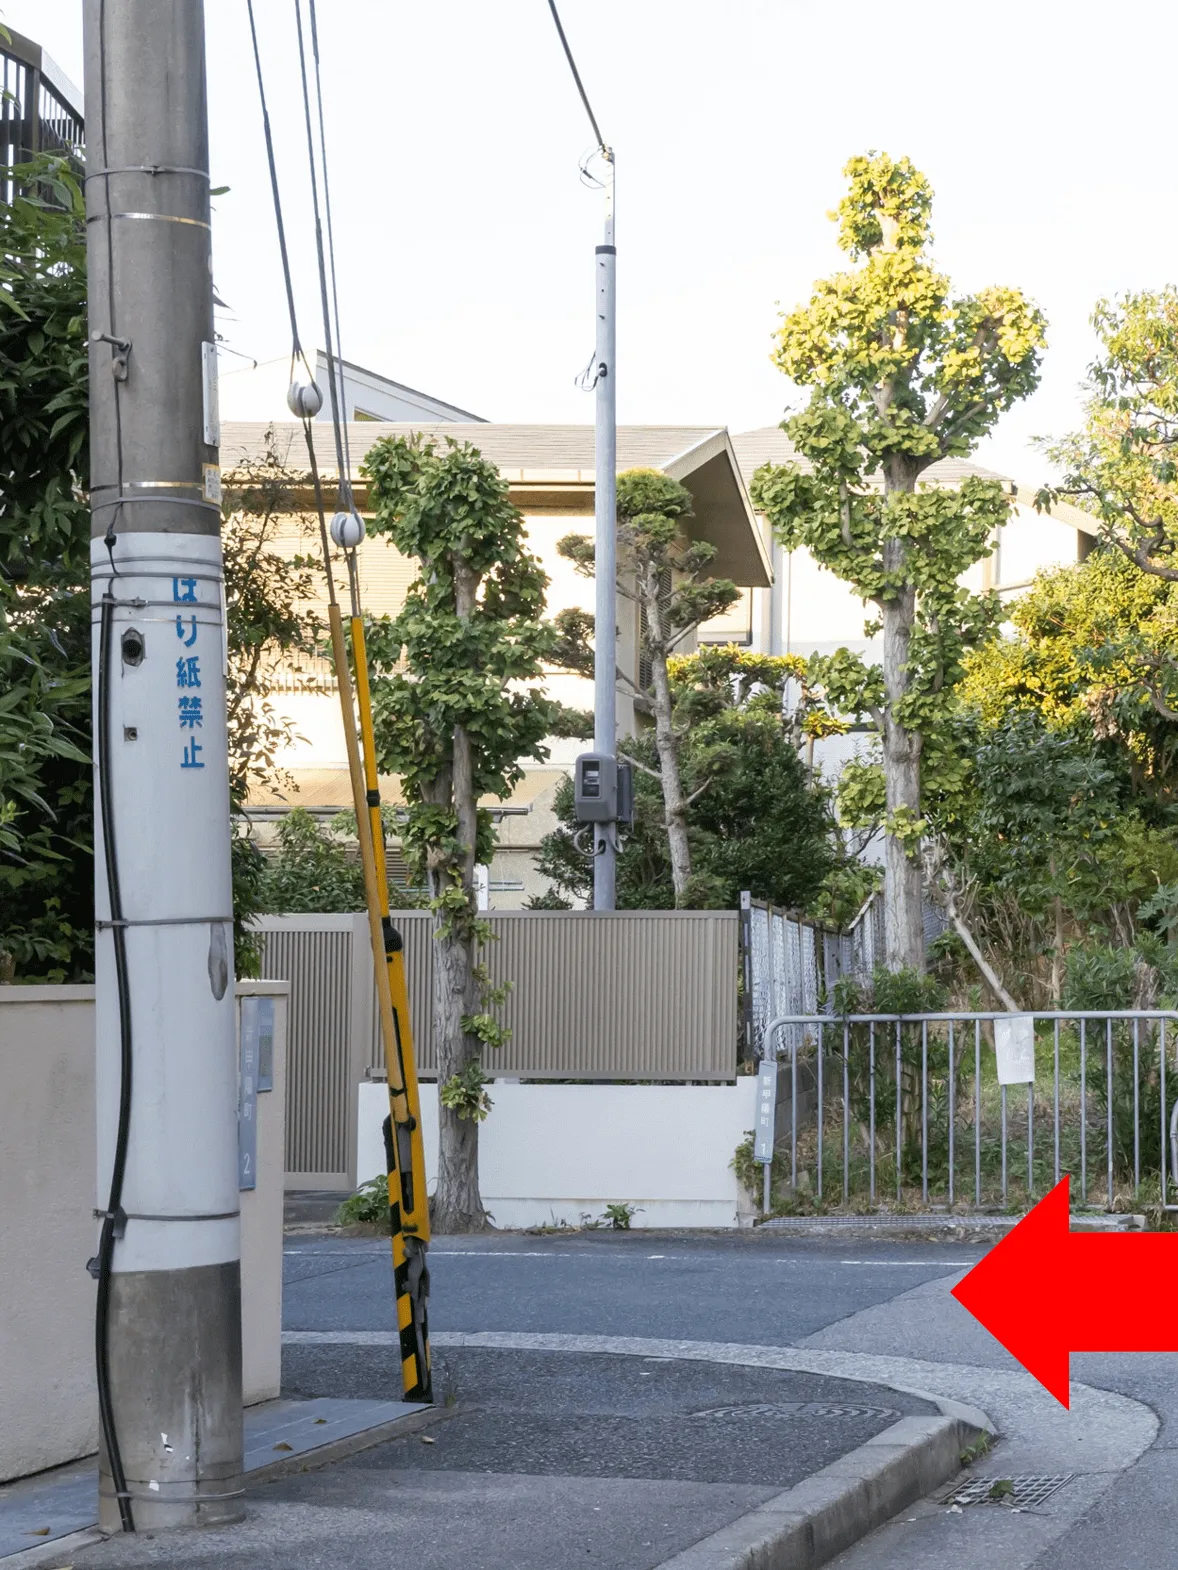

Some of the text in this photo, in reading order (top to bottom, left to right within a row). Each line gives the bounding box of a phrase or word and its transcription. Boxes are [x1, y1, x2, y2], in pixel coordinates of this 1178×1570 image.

[172, 577, 205, 768] はり紙禁止
[243, 1153, 251, 1175] 2
